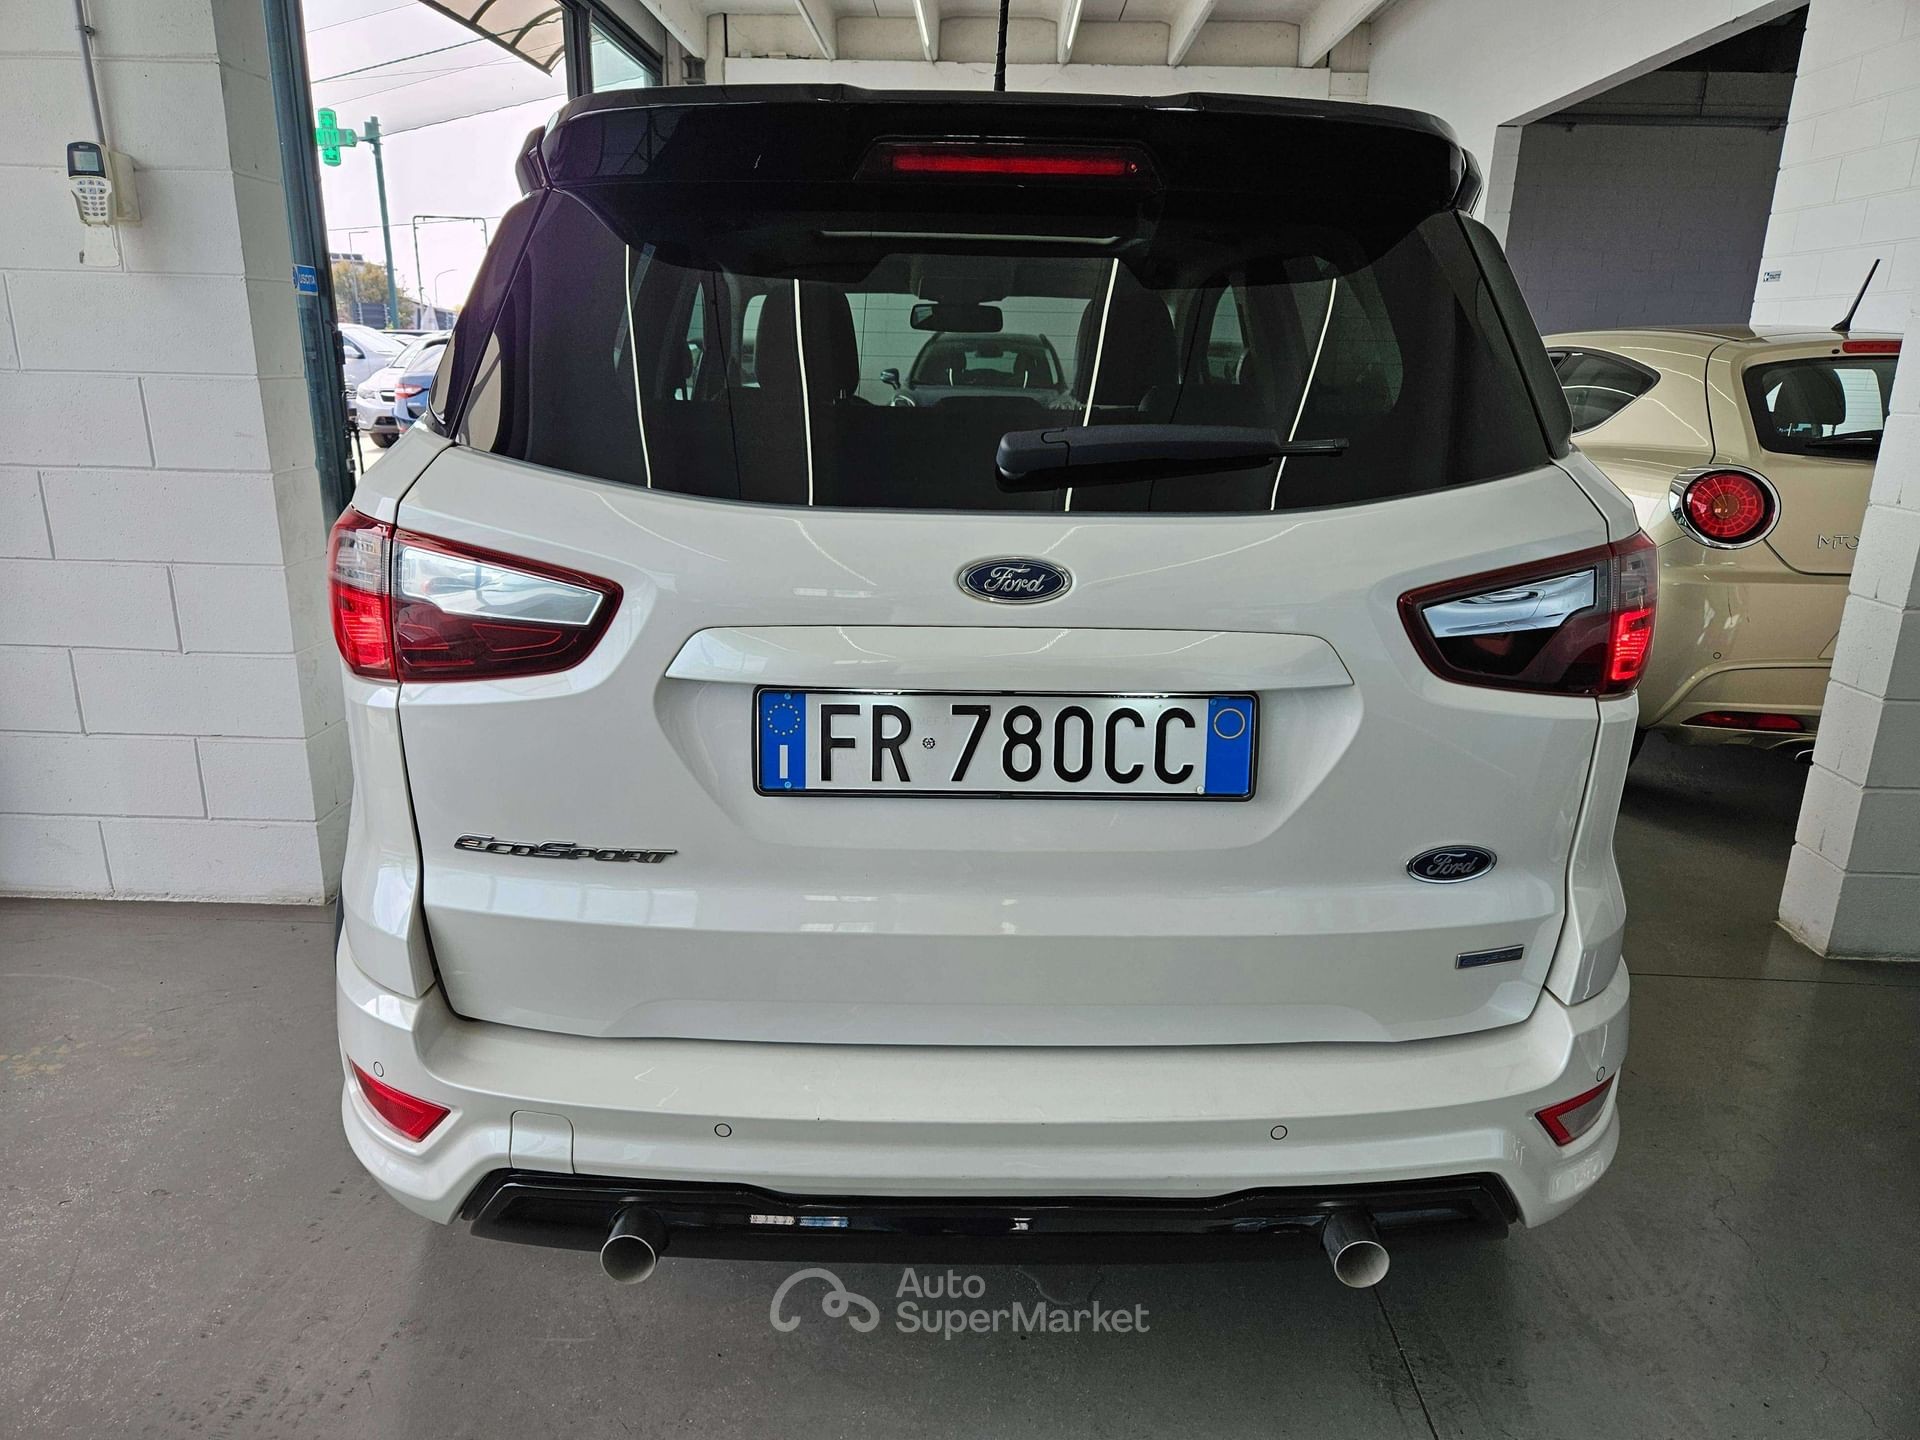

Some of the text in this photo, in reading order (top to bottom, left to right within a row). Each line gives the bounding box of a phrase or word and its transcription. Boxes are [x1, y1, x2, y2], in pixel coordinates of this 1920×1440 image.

[984, 566, 1046, 592] Ford
[820, 704, 911, 782] FR
[951, 704, 1196, 785] 780CC
[1426, 852, 1479, 875] Ford
